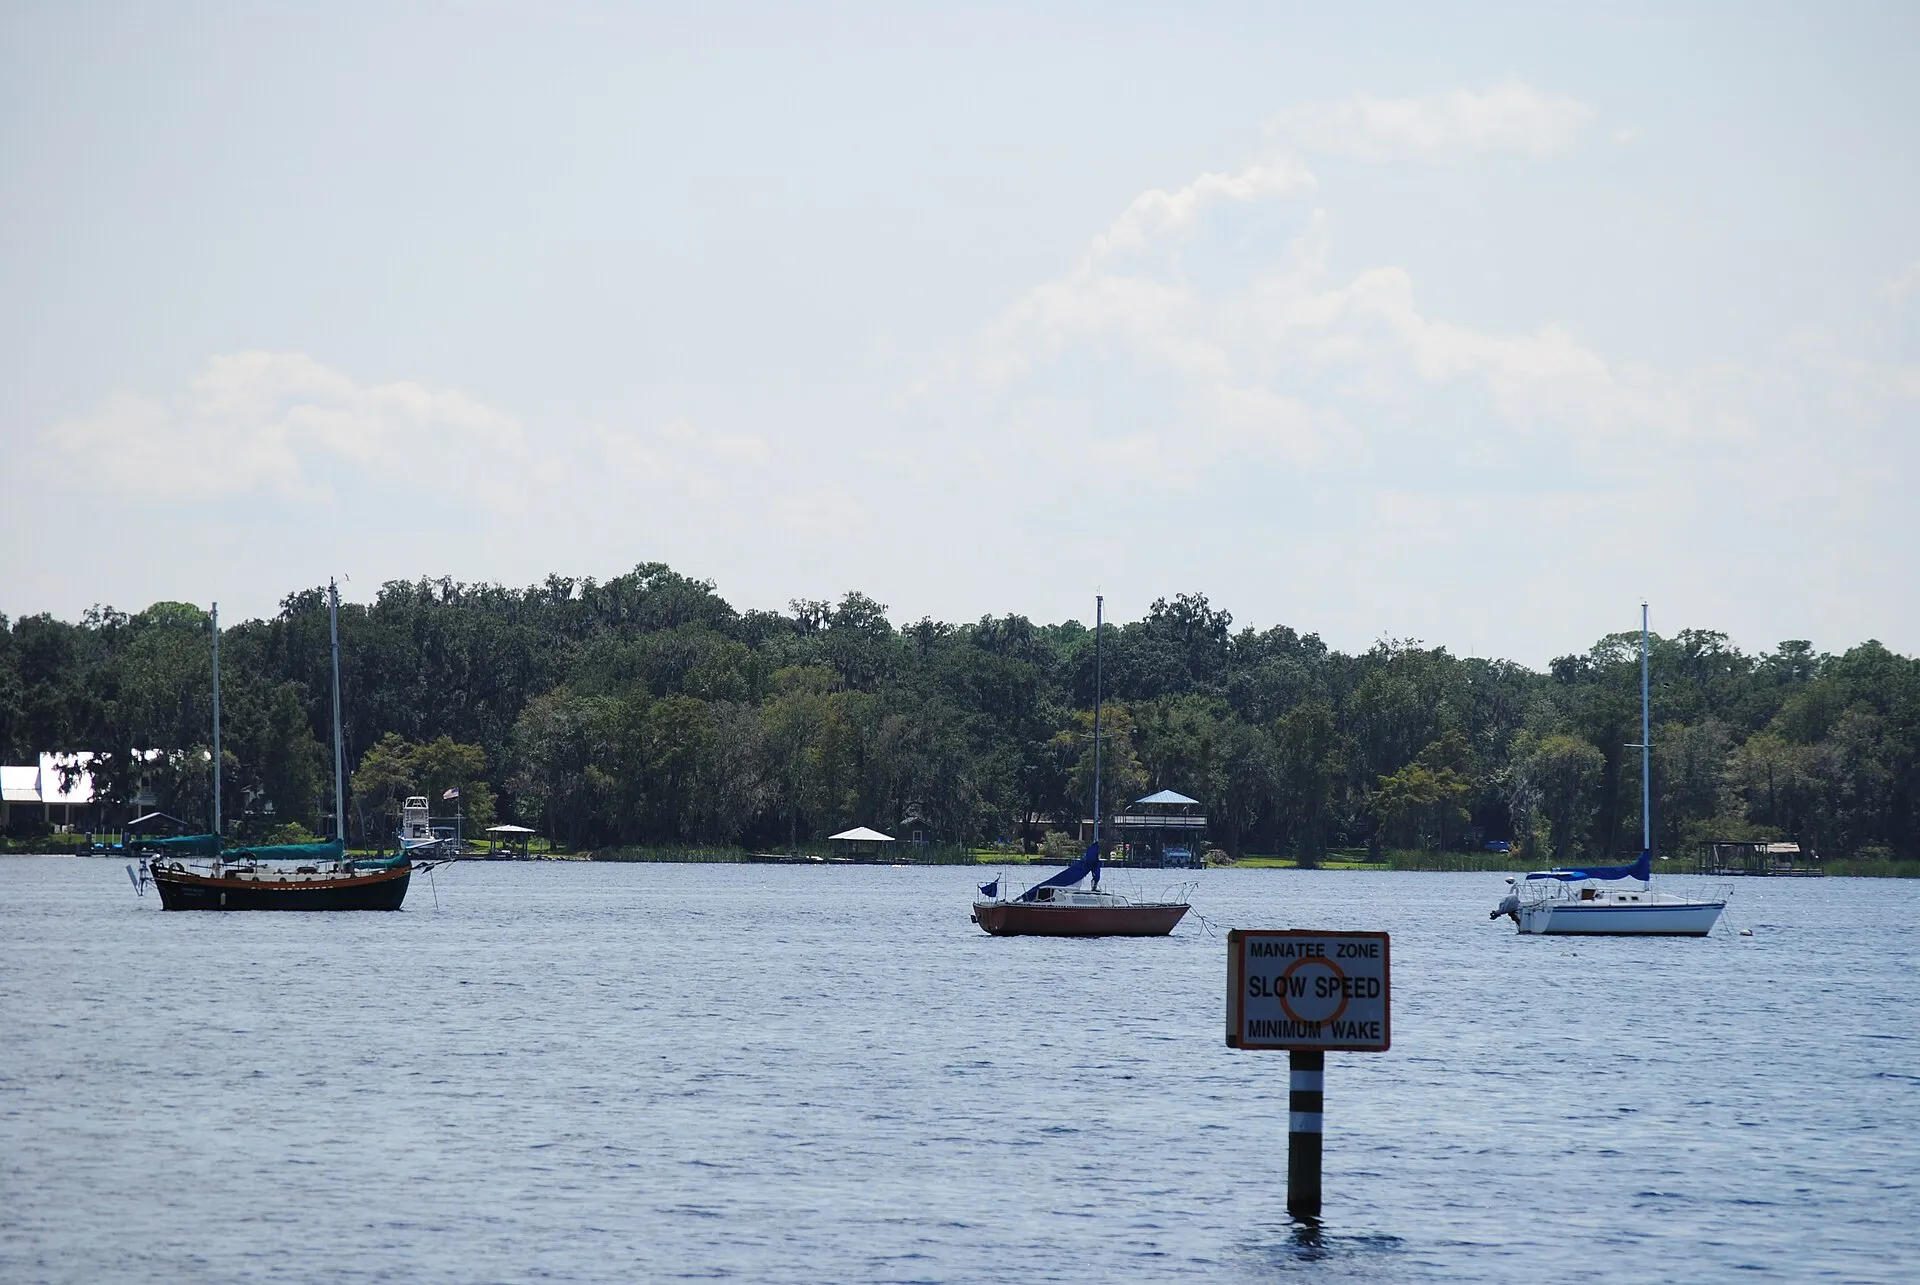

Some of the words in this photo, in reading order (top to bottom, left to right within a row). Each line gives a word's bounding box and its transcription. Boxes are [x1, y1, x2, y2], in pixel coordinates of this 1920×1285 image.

[1250, 943, 1325, 958] MANATEE
[1336, 944, 1379, 958] ZONE
[1248, 976, 1307, 998] SLOW
[1315, 976, 1380, 999] SPEED
[1248, 1020, 1322, 1039] MINIMUM
[1331, 1021, 1380, 1039] WAKE
